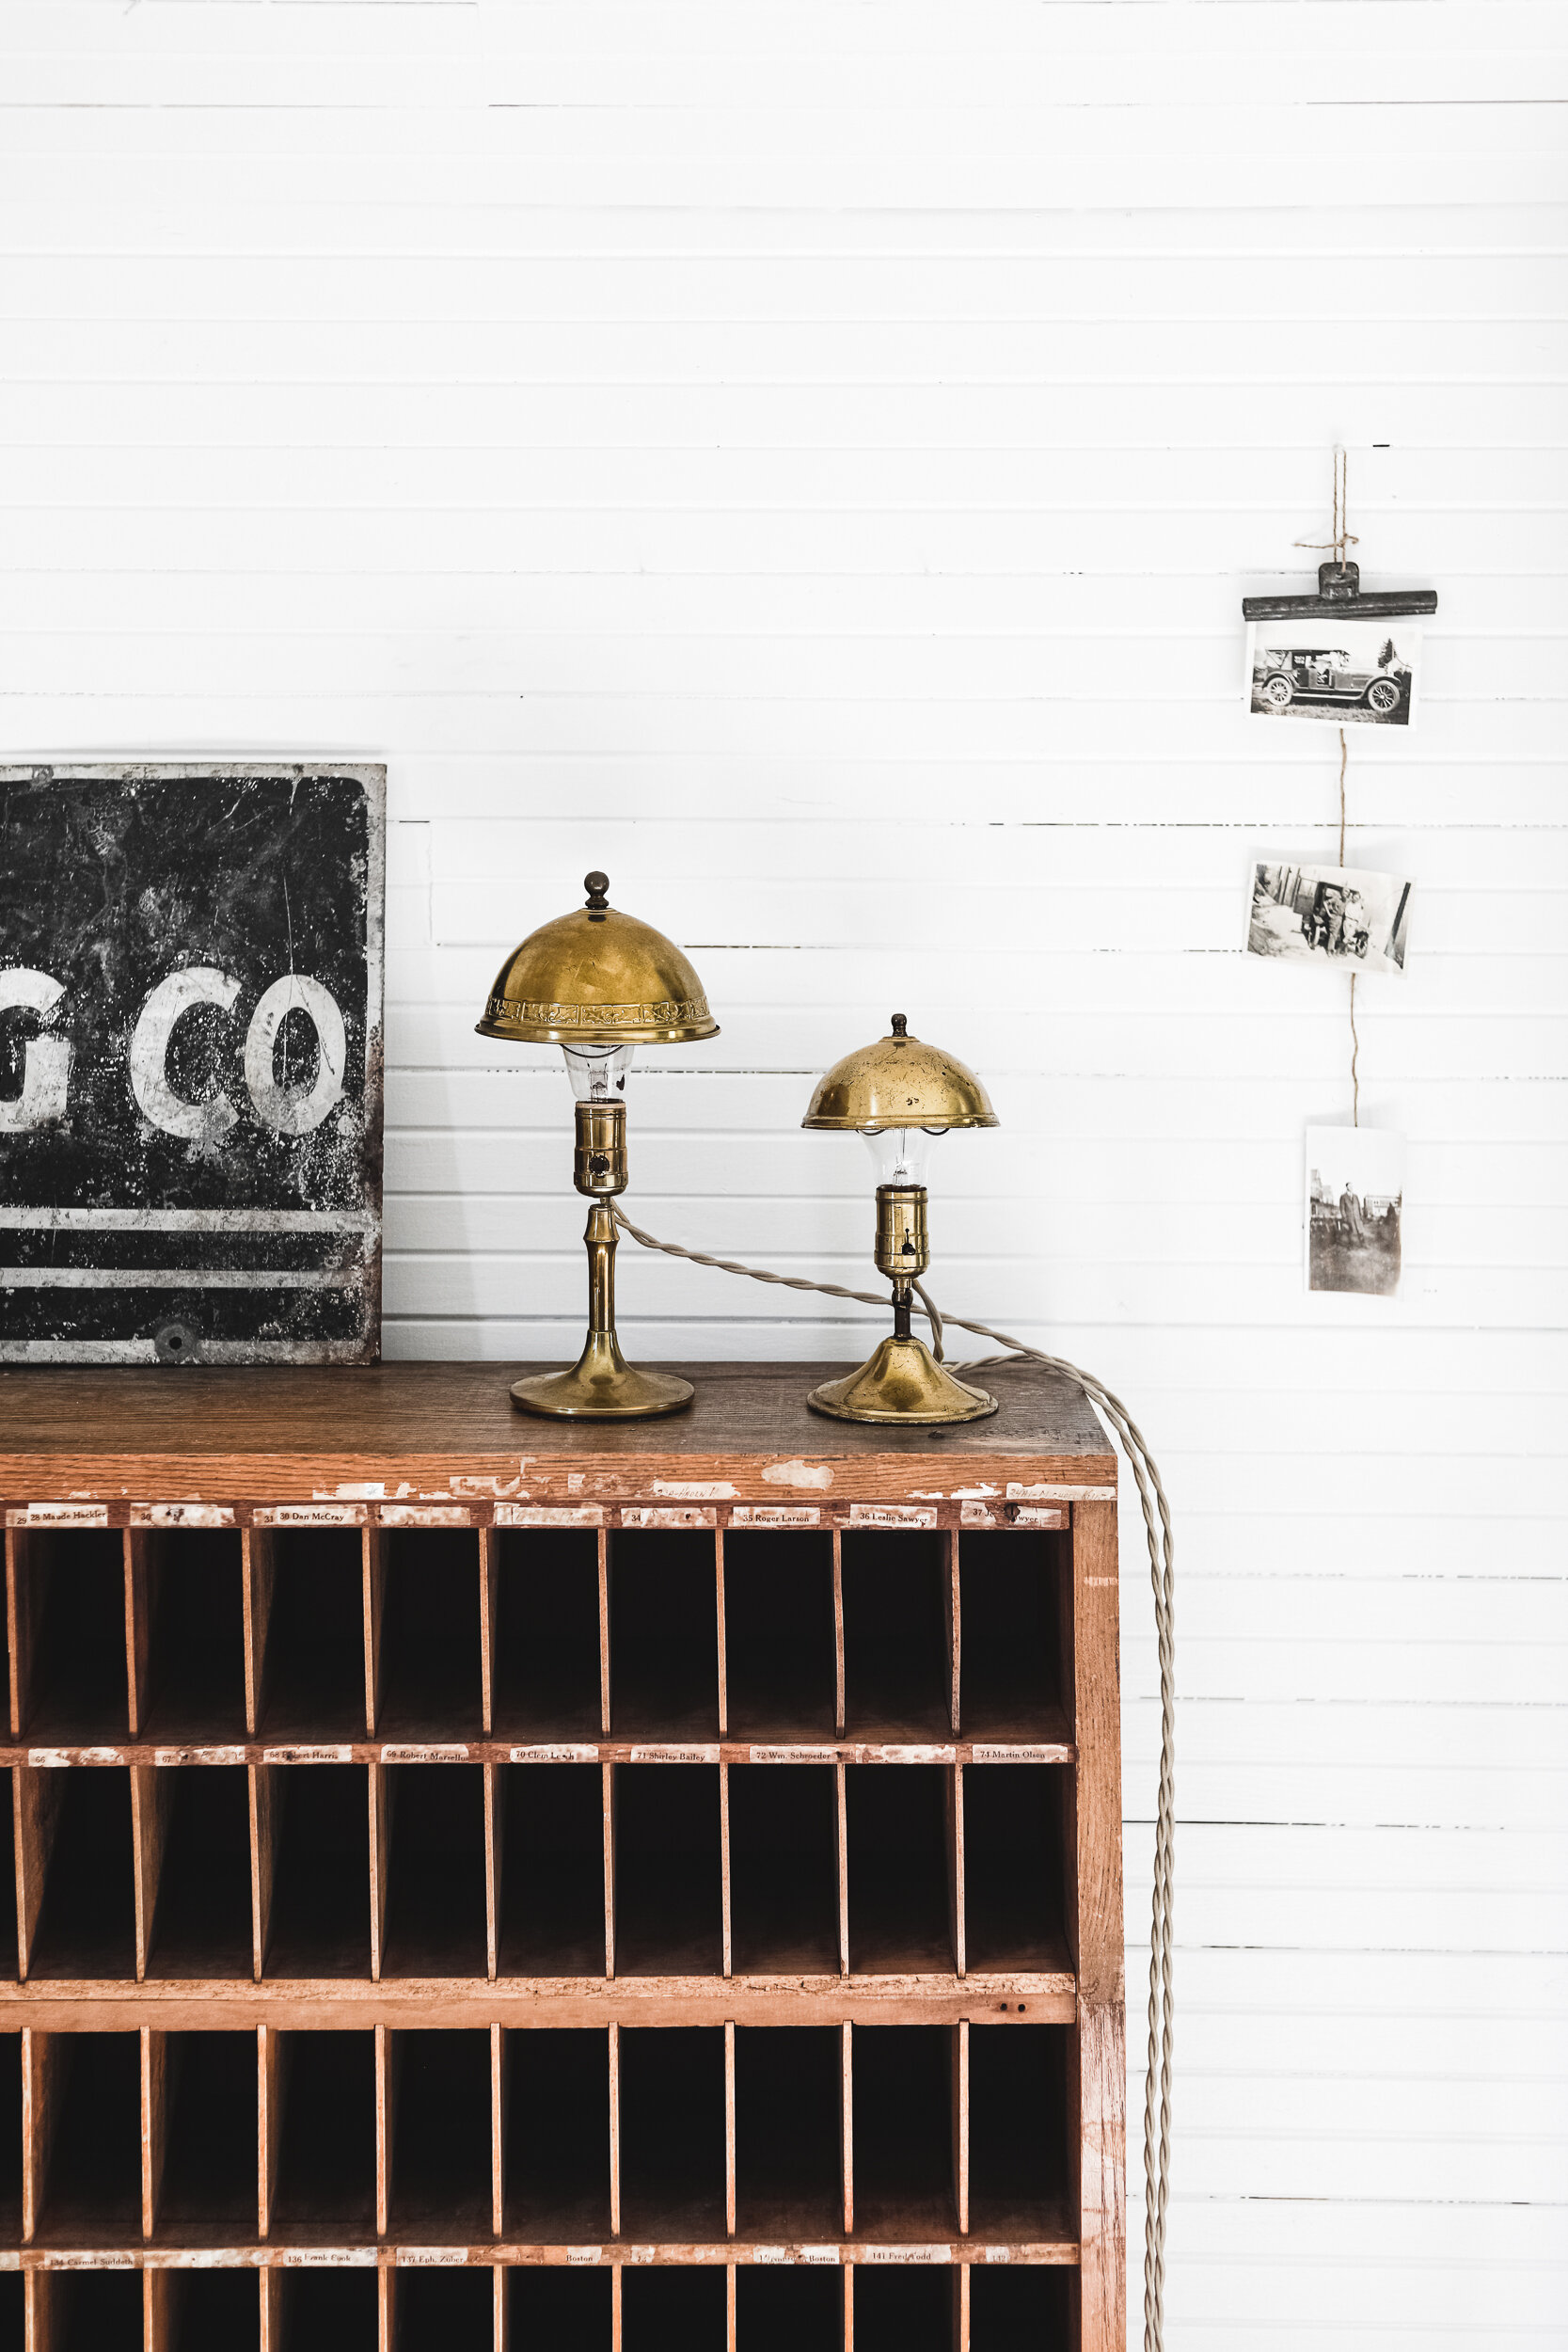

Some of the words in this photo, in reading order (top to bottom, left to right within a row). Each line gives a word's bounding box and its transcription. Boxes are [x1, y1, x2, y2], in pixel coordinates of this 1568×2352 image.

[42, 1512, 71, 1520] Maude
[72, 1510, 106, 1519] Hackler
[973, 1508, 983, 1517] 37
[17, 1517, 27, 1525] 29
[264, 1515, 274, 1523] 31
[279, 1512, 290, 1520] 30
[312, 1513, 344, 1522] McCray
[755, 1515, 780, 1523] Roger
[872, 1513, 895, 1521] Leslie
[400, 1751, 427, 1759] Robert
[649, 1753, 677, 1761] Shirley
[679, 1754, 705, 1762] Bailey
[289, 2255, 302, 2264] 136
